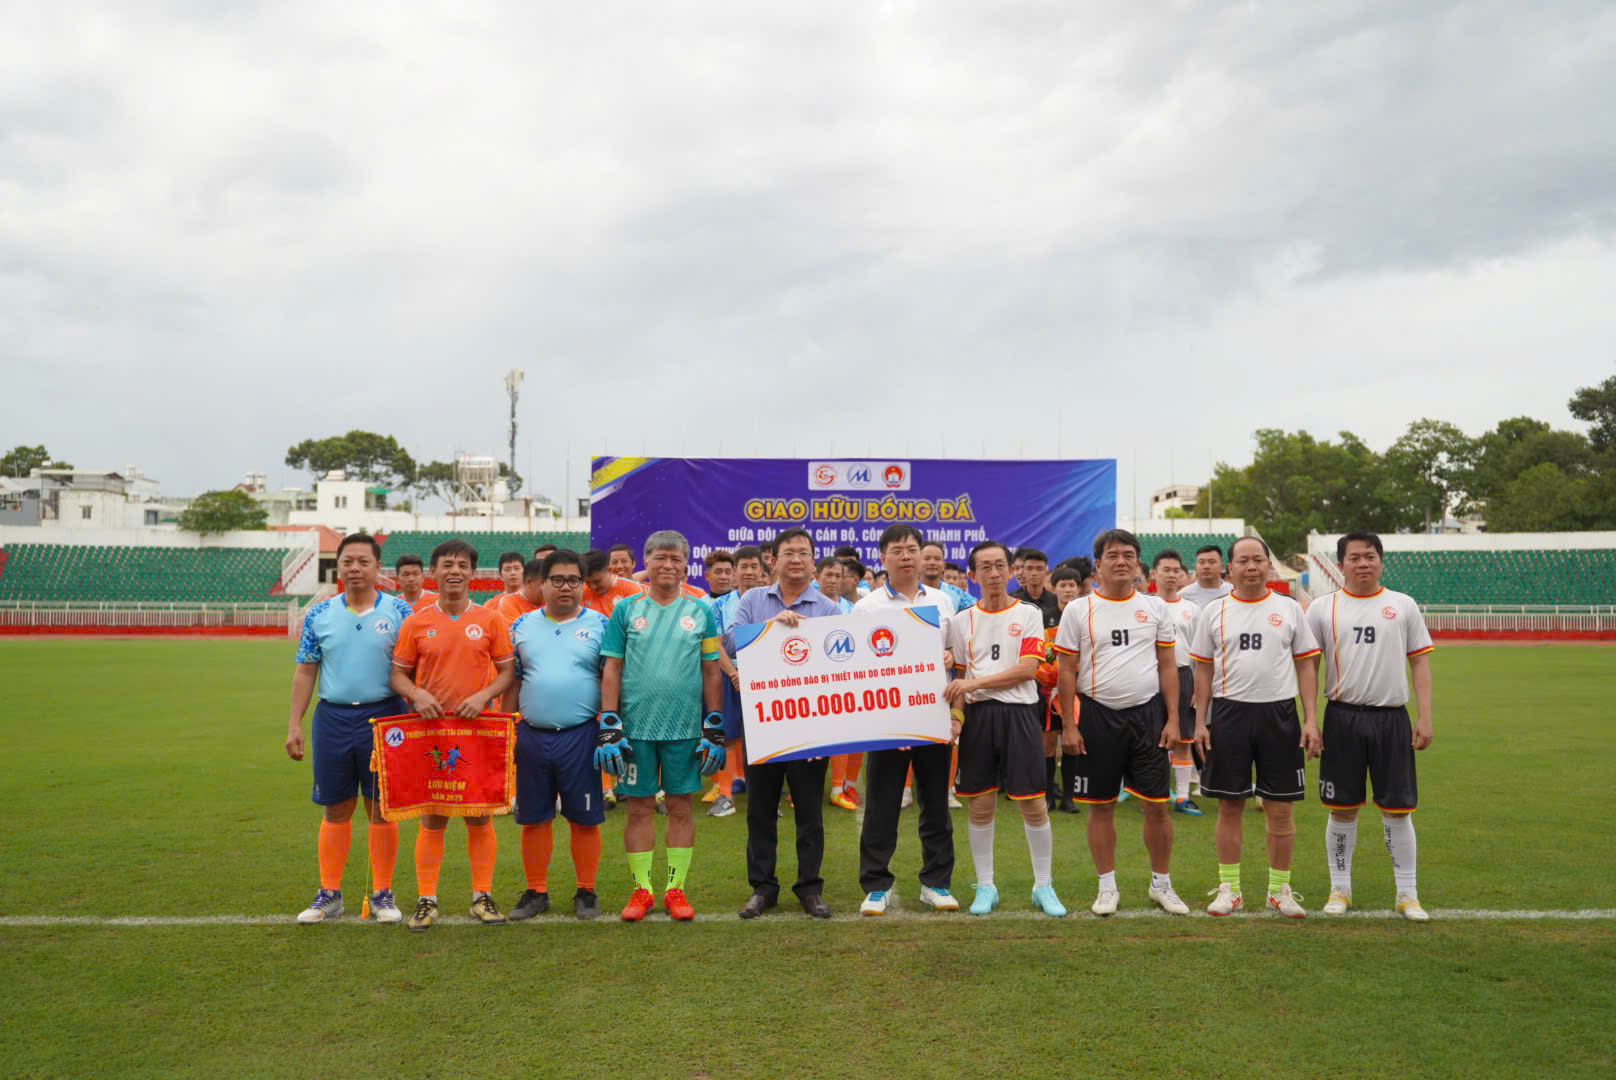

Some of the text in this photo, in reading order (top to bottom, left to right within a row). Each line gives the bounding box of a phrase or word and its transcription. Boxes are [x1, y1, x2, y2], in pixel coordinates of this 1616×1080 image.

[747, 494, 974, 521] GIAO HỮU BÓNG ĐÁ
[728, 526, 754, 542] GIỮA
[816, 526, 837, 542] CÁN
[927, 527, 961, 542] THÀNH
[964, 525, 989, 542] PHỐ,
[1111, 629, 1129, 647] 91
[1239, 633, 1262, 650] 88
[1353, 626, 1376, 644] 79
[991, 644, 1000, 661] 8
[750, 680, 766, 691] ỦNG
[768, 678, 779, 690] HỘ
[781, 676, 802, 688] ĐỒNG
[804, 674, 819, 685] BÀO
[821, 674, 829, 684] BỊ
[831, 671, 851, 683] THIỆT
[868, 669, 878, 678] DO
[880, 667, 896, 677] CƠN
[915, 661, 924, 673] SỐ
[926, 663, 935, 672] 10
[755, 687, 936, 723] 1.000.000.000 ĐỒNG
[1320, 780, 1335, 799] 79
[584, 793, 591, 811] 1
